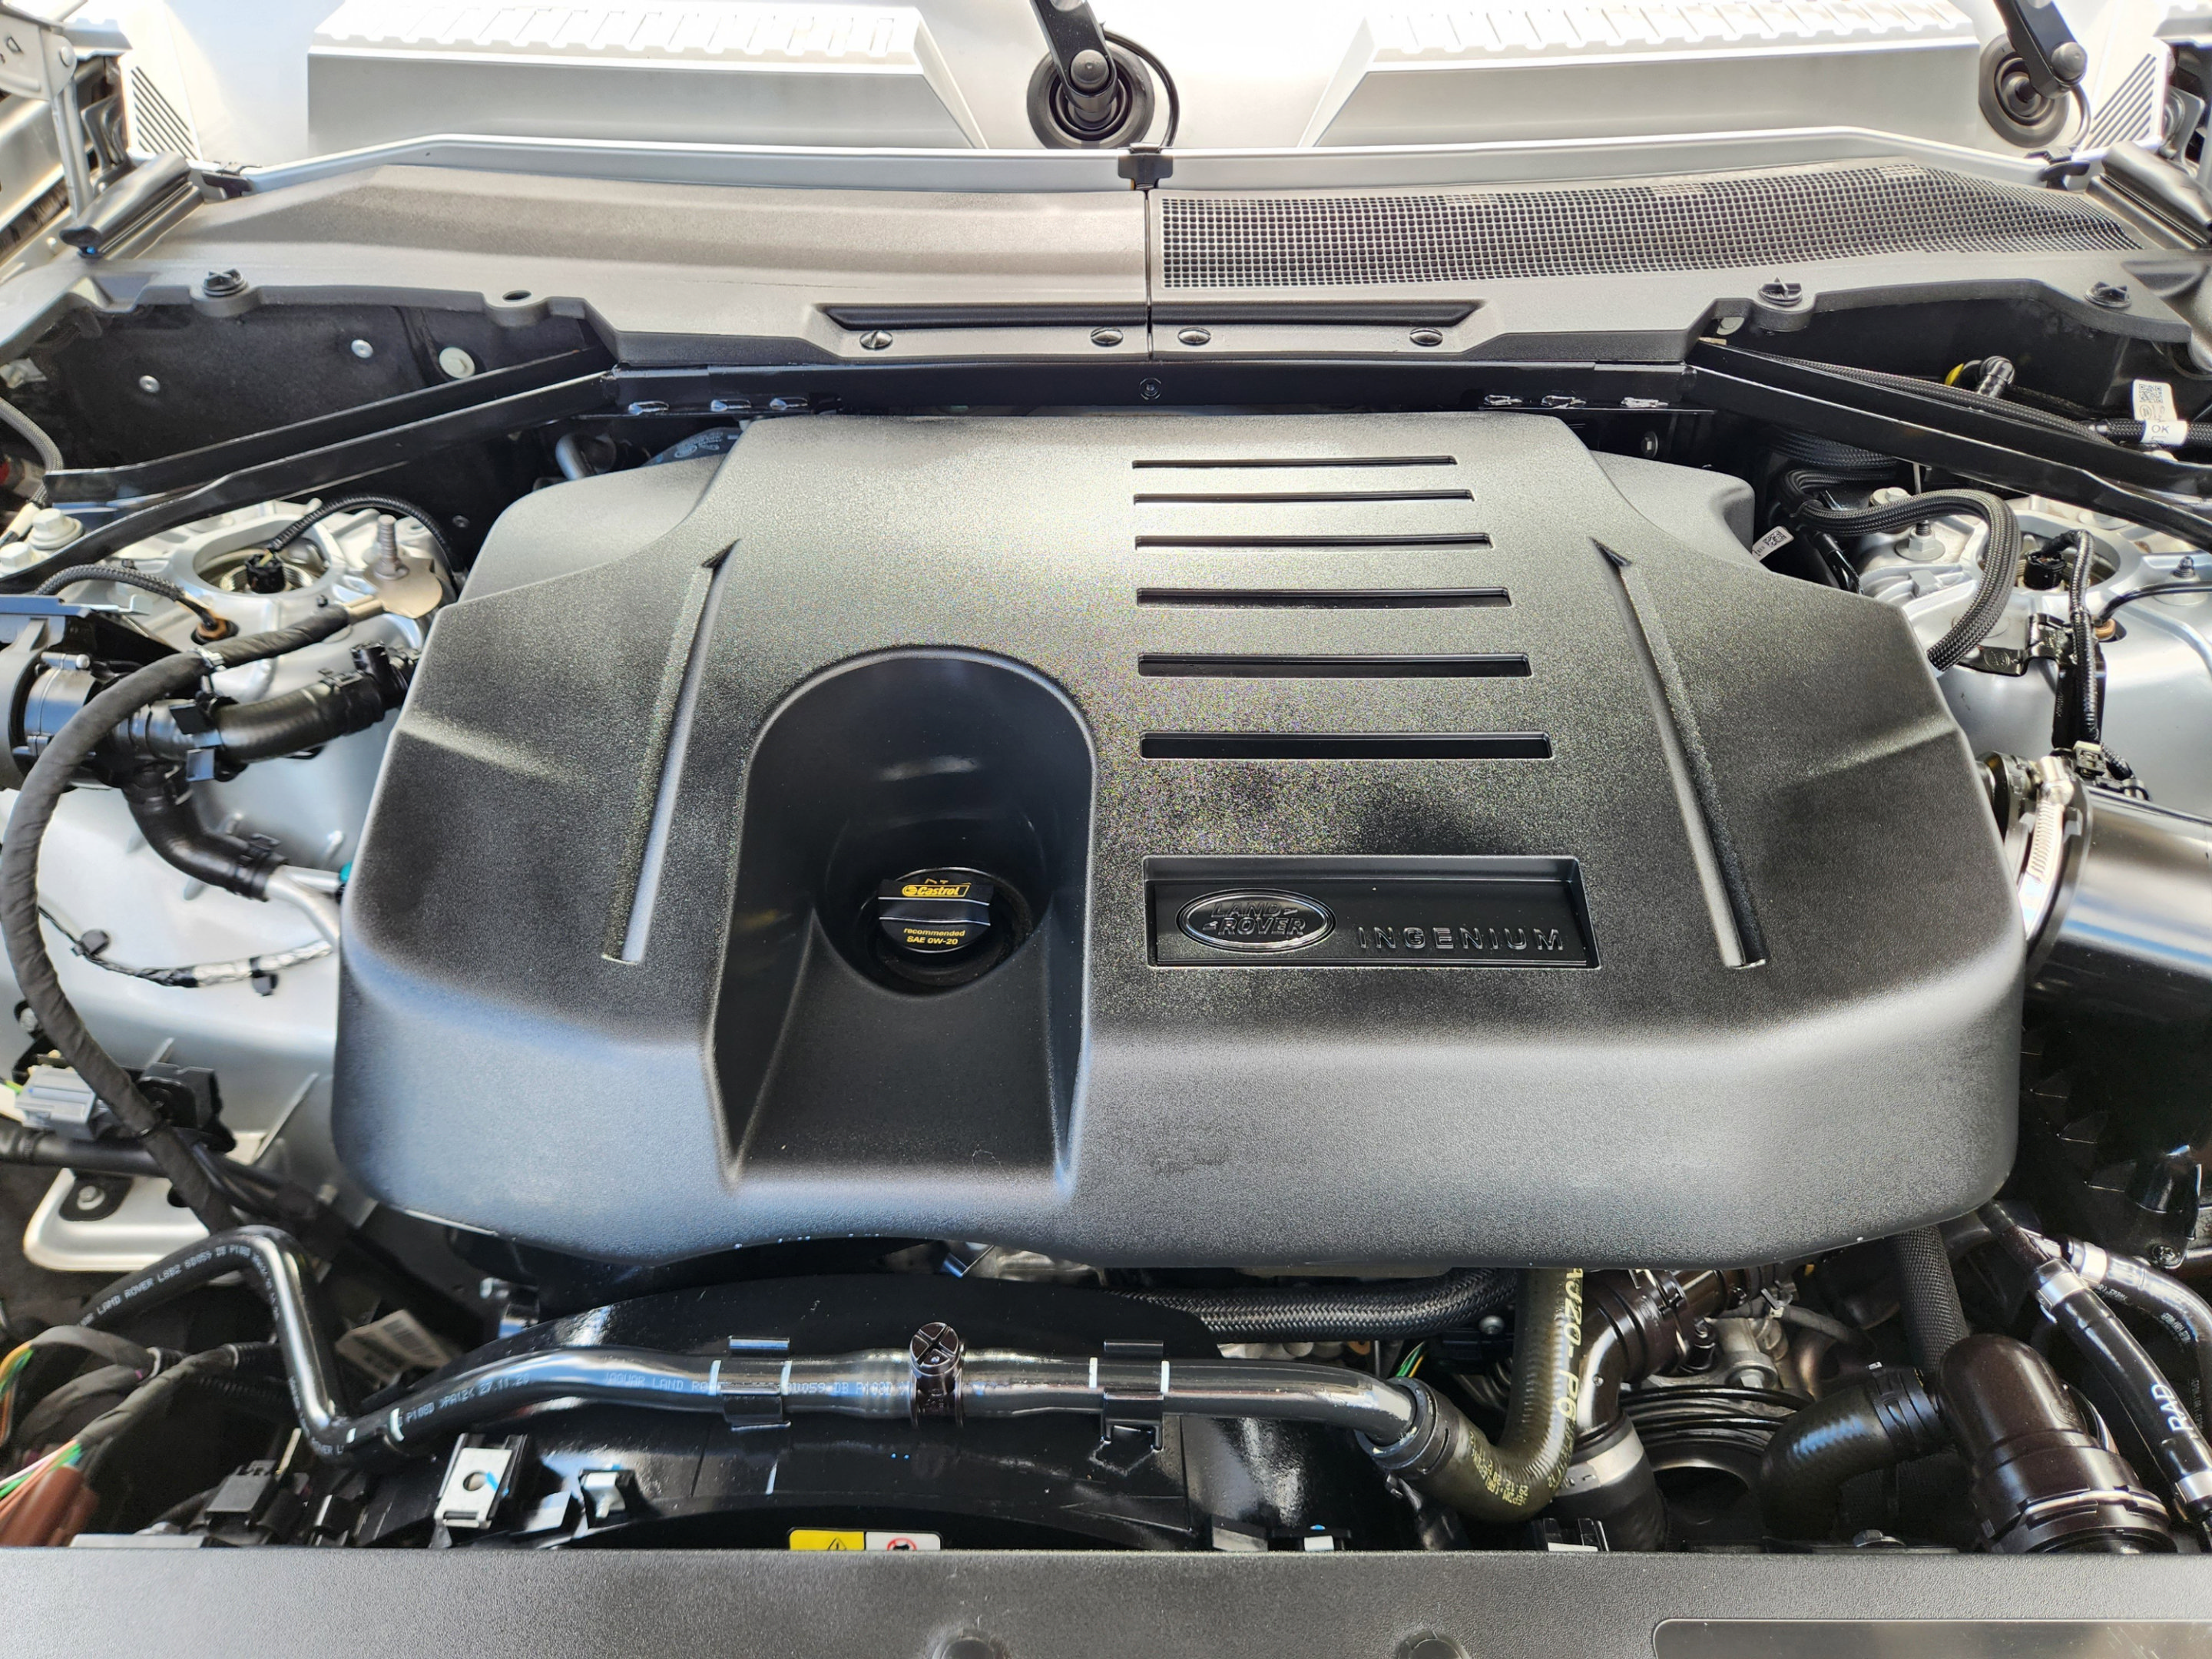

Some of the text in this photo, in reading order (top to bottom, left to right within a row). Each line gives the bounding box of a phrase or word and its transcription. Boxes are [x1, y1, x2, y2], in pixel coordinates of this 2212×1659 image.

[2151, 424, 2170, 434] OK
[917, 886, 959, 896] Castrol
[1210, 901, 1282, 918] LAND
[904, 927, 965, 937] recommended
[1217, 917, 1306, 935] ROVER
[906, 935, 959, 945] SAE 0W-20
[1356, 926, 1565, 950] INGENIUM
[604, 1372, 646, 1389] JAGUAR
[651, 1376, 684, 1391] LAND
[2151, 1384, 2194, 1432] RAD
